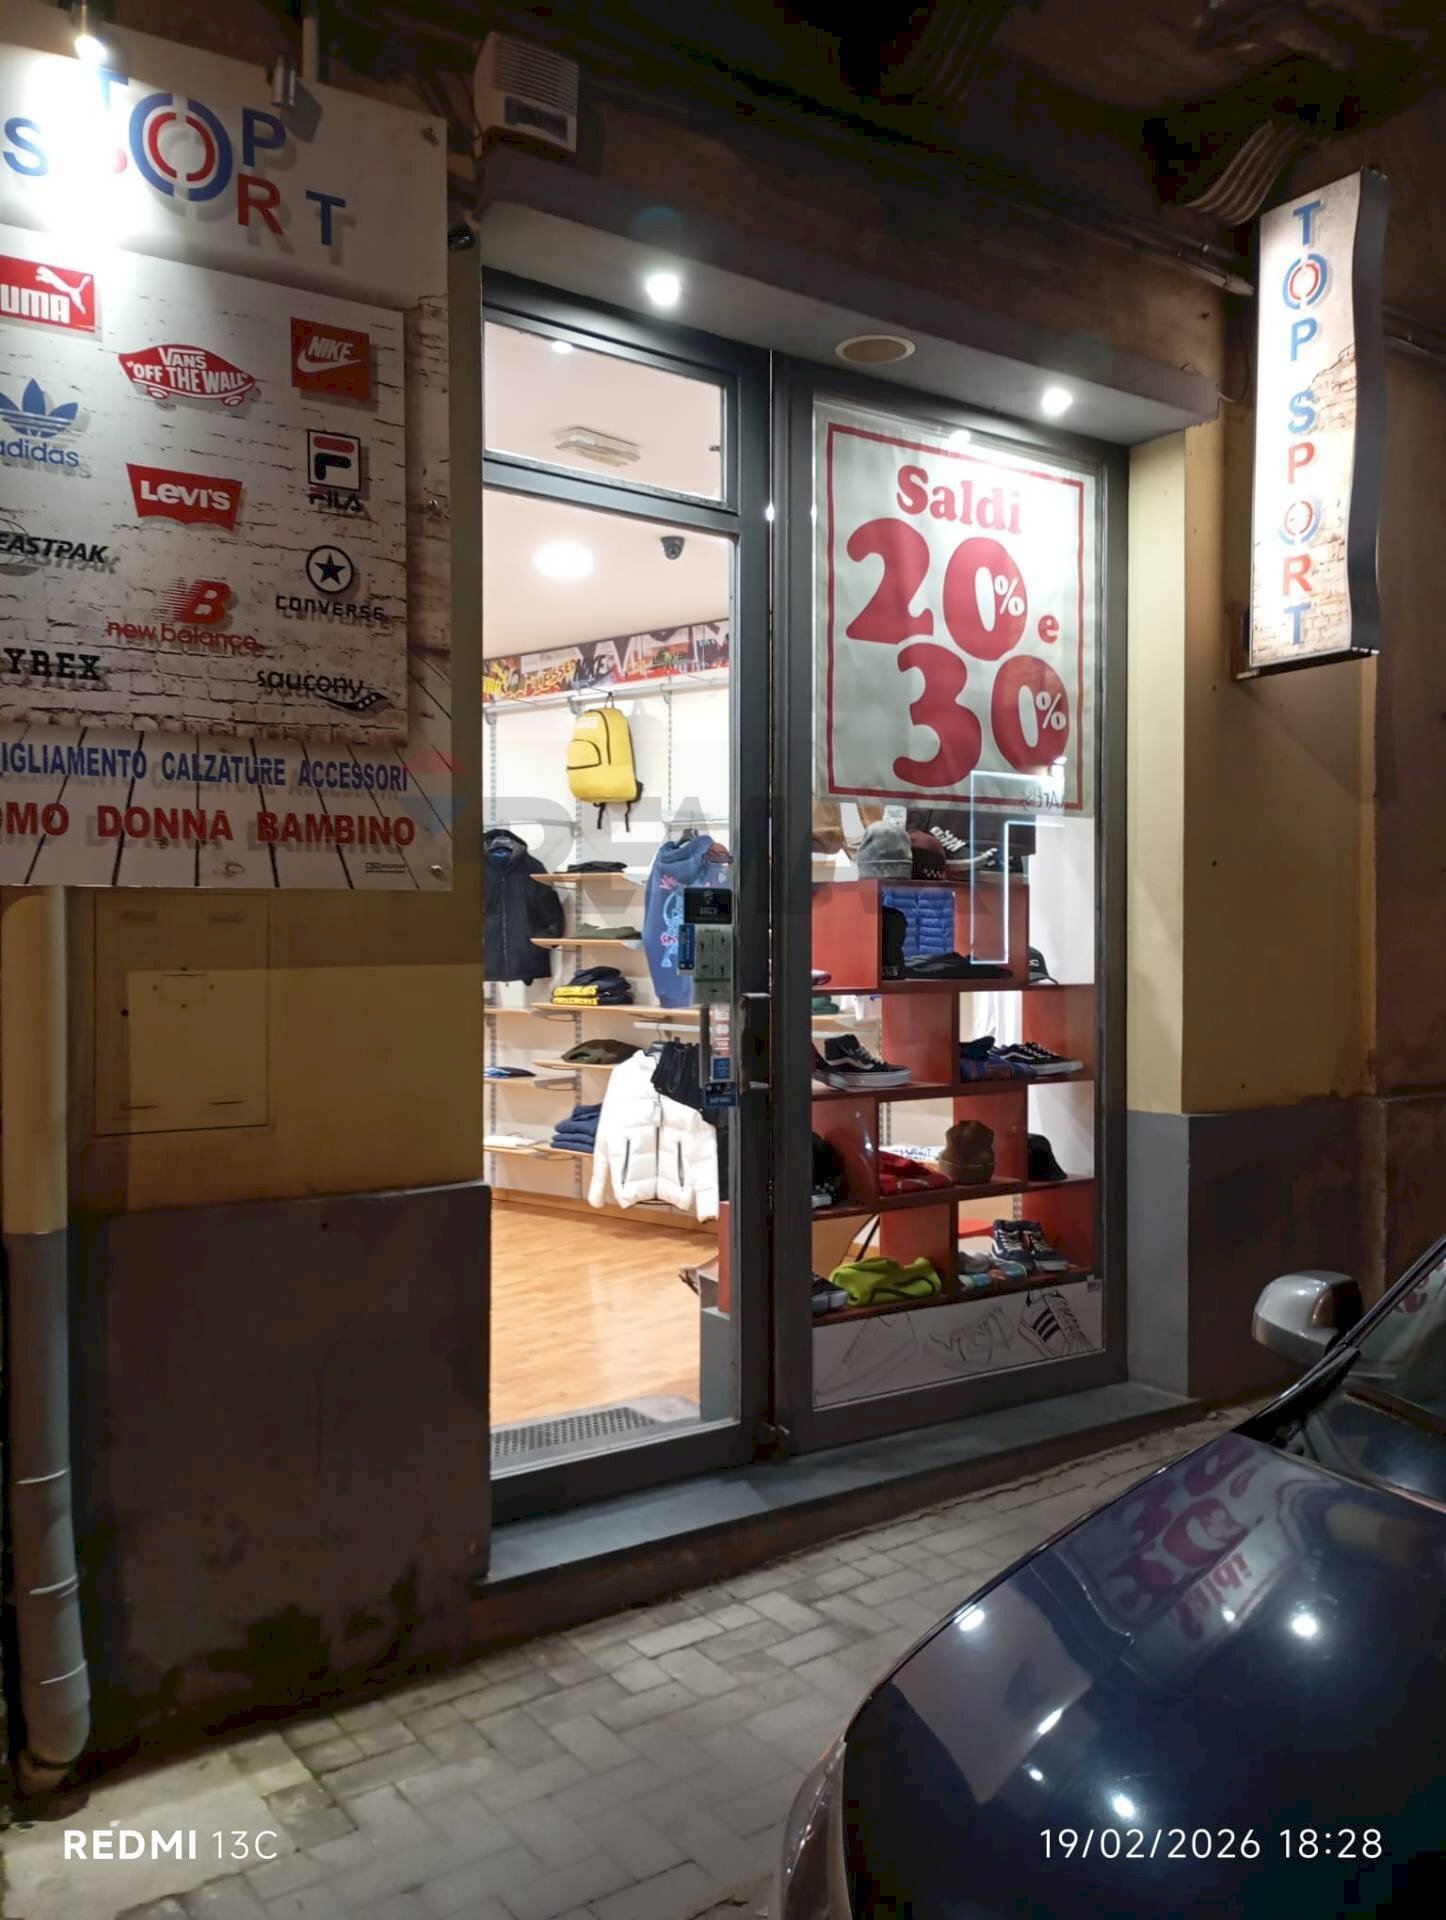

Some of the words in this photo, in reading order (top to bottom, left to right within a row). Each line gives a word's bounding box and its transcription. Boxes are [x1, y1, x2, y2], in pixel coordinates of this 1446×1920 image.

[1281, 199, 1328, 362] TOP
[158, 347, 207, 370] VANS
[306, 335, 355, 362] NIKE
[165, 366, 201, 393] THE
[308, 485, 364, 513] FILA
[896, 464, 1023, 535] Saldi
[1278, 389, 1321, 646] SPORT
[845, 516, 1029, 662] 20%
[1037, 613, 1060, 644] e
[276, 595, 385, 621] CONVERSE
[106, 620, 157, 641] new
[160, 622, 257, 651] balance
[256, 669, 365, 699] saucony
[892, 641, 1071, 788] 30%
[161, 751, 287, 787] CALZATURE
[297, 760, 408, 792] ACCESSORI
[0, 801, 70, 837] MO
[96, 804, 234, 842] DONNA
[256, 811, 415, 847] BAMBINO
